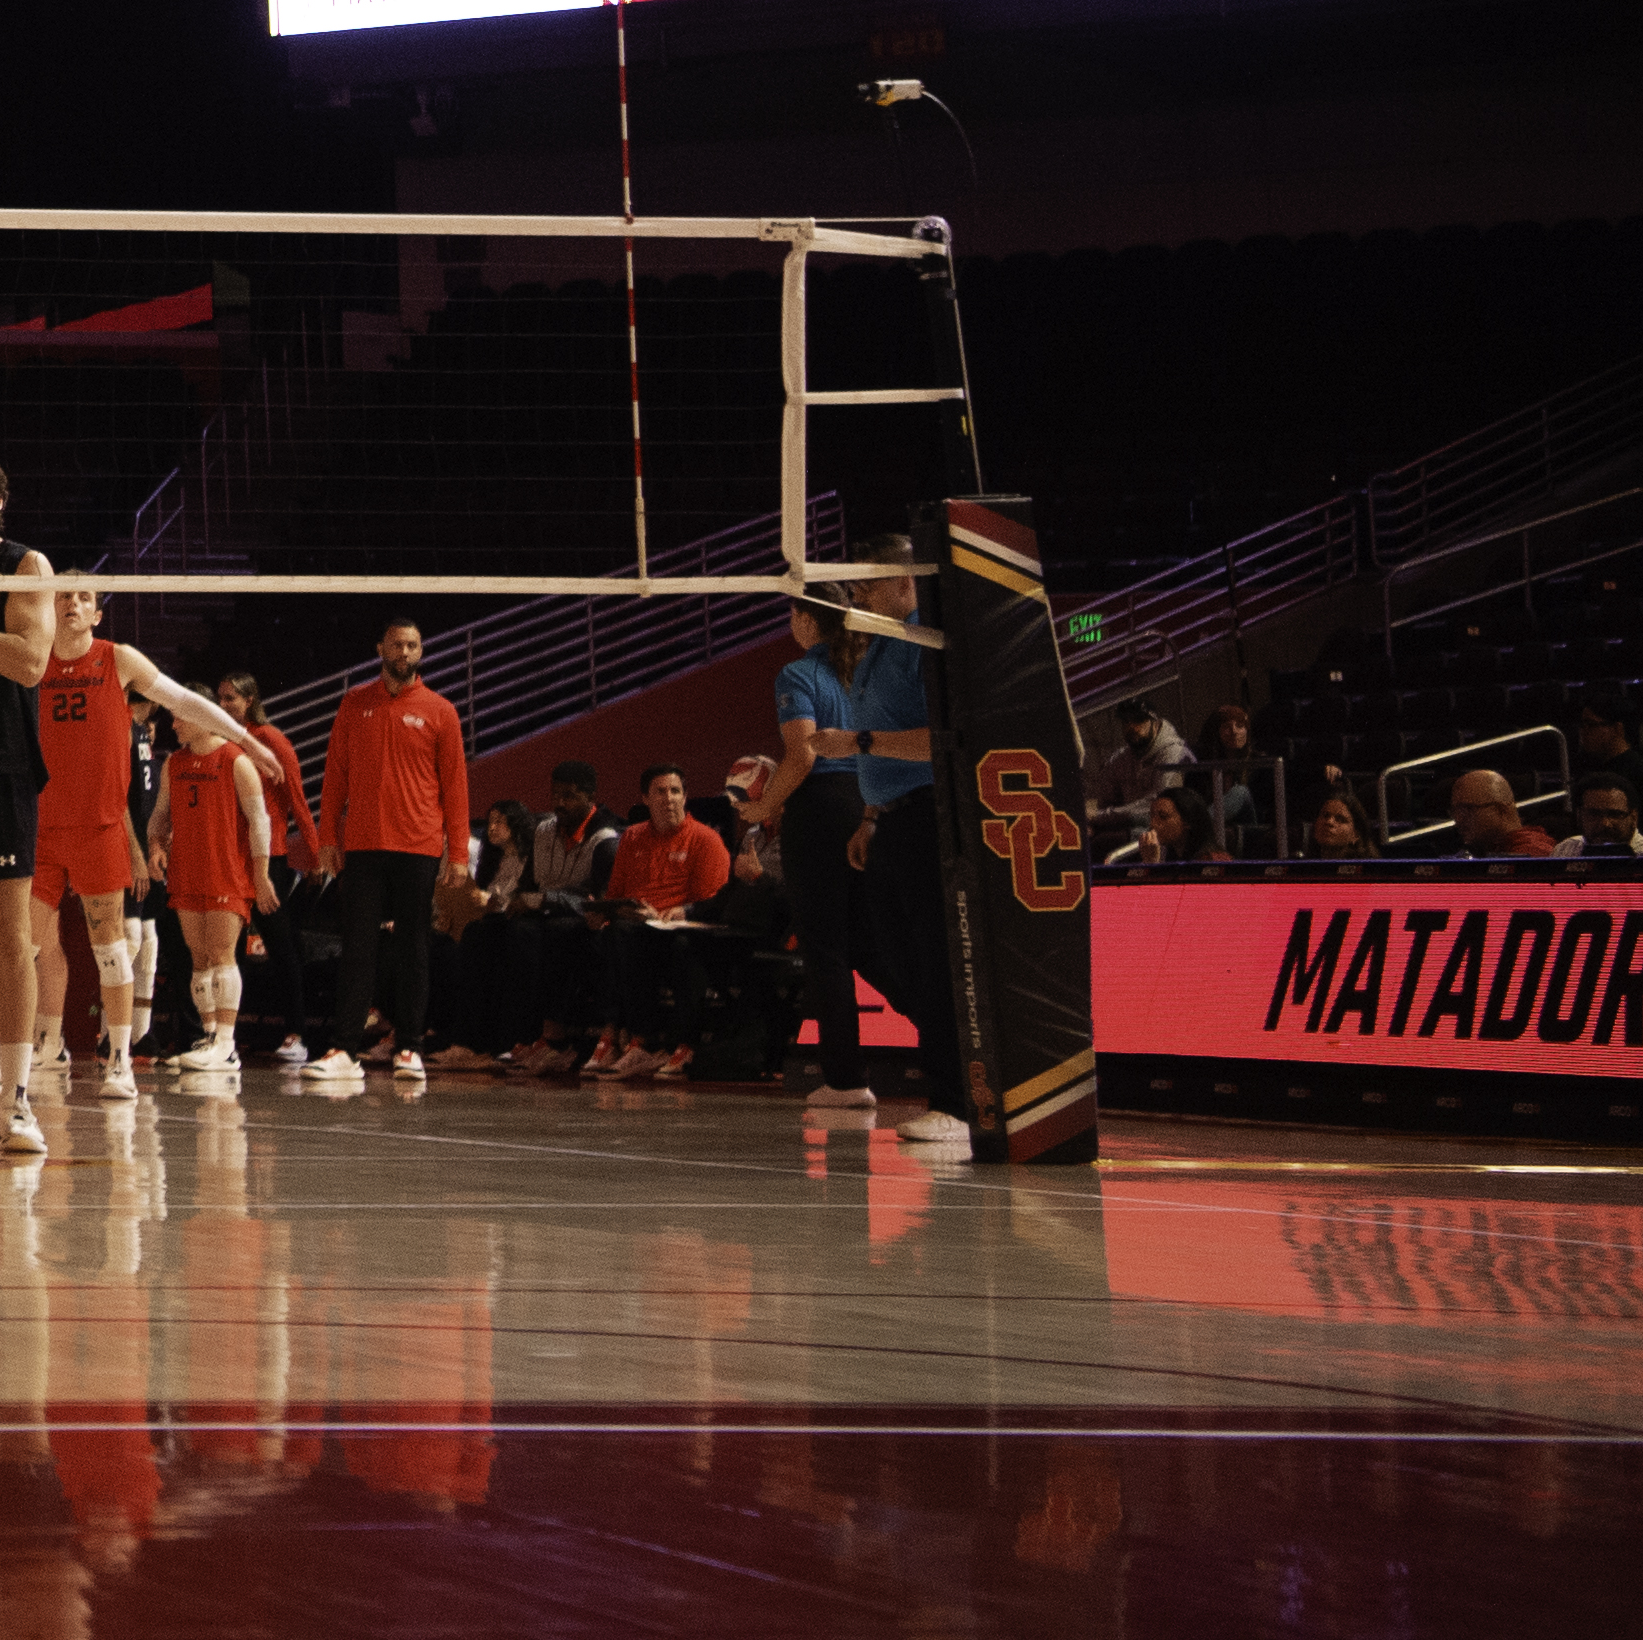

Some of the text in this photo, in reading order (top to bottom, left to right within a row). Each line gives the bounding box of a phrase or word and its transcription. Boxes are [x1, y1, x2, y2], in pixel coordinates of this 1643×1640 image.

[52, 693, 87, 722] 22
[975, 748, 1086, 912] SC
[956, 890, 981, 1049] sports imports
[1264, 908, 1643, 1046] MATADOR
